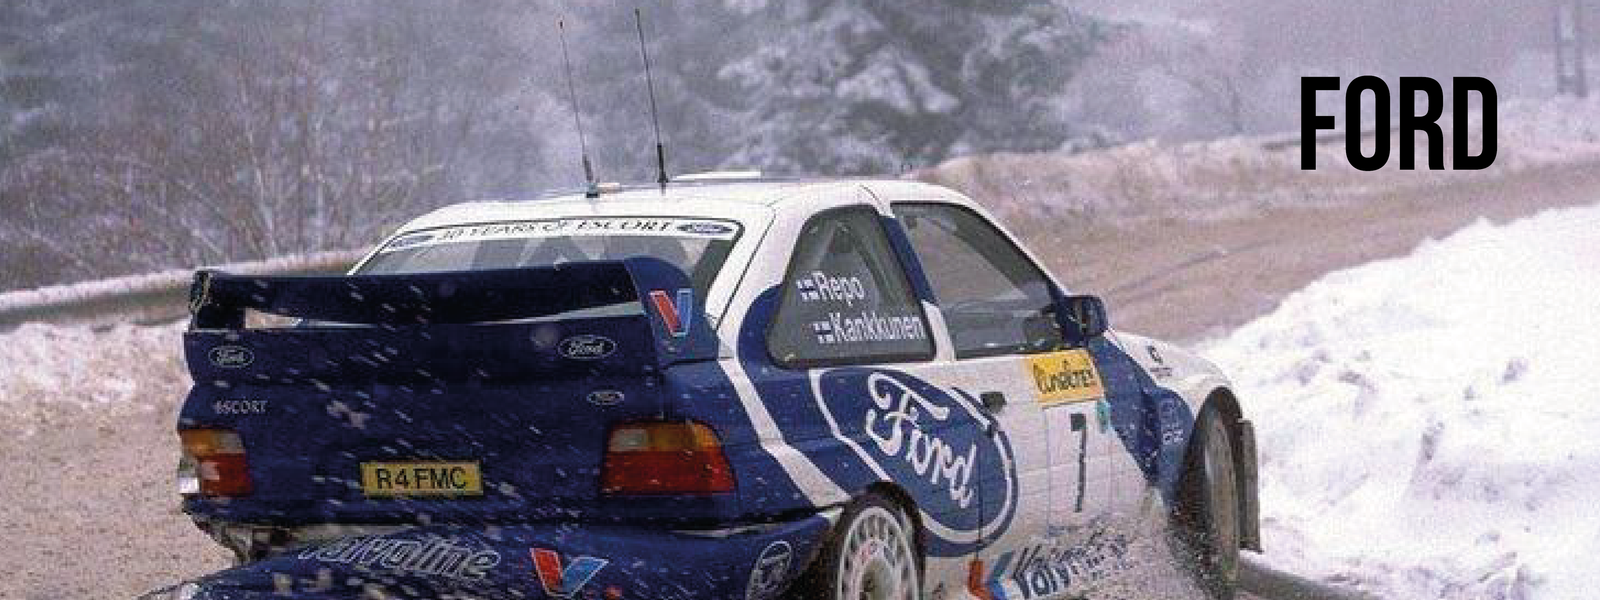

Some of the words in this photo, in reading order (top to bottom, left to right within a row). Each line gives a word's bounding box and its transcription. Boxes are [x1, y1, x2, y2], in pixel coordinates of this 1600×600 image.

[470, 224, 534, 236] YEARS
[577, 219, 672, 232] ESCORT
[812, 270, 865, 307] Repo
[829, 311, 925, 342] Kankkunen
[214, 400, 269, 415] ESCORT
[866, 371, 977, 509] Ford
[376, 468, 410, 489] R4
[413, 466, 468, 489] FMC
